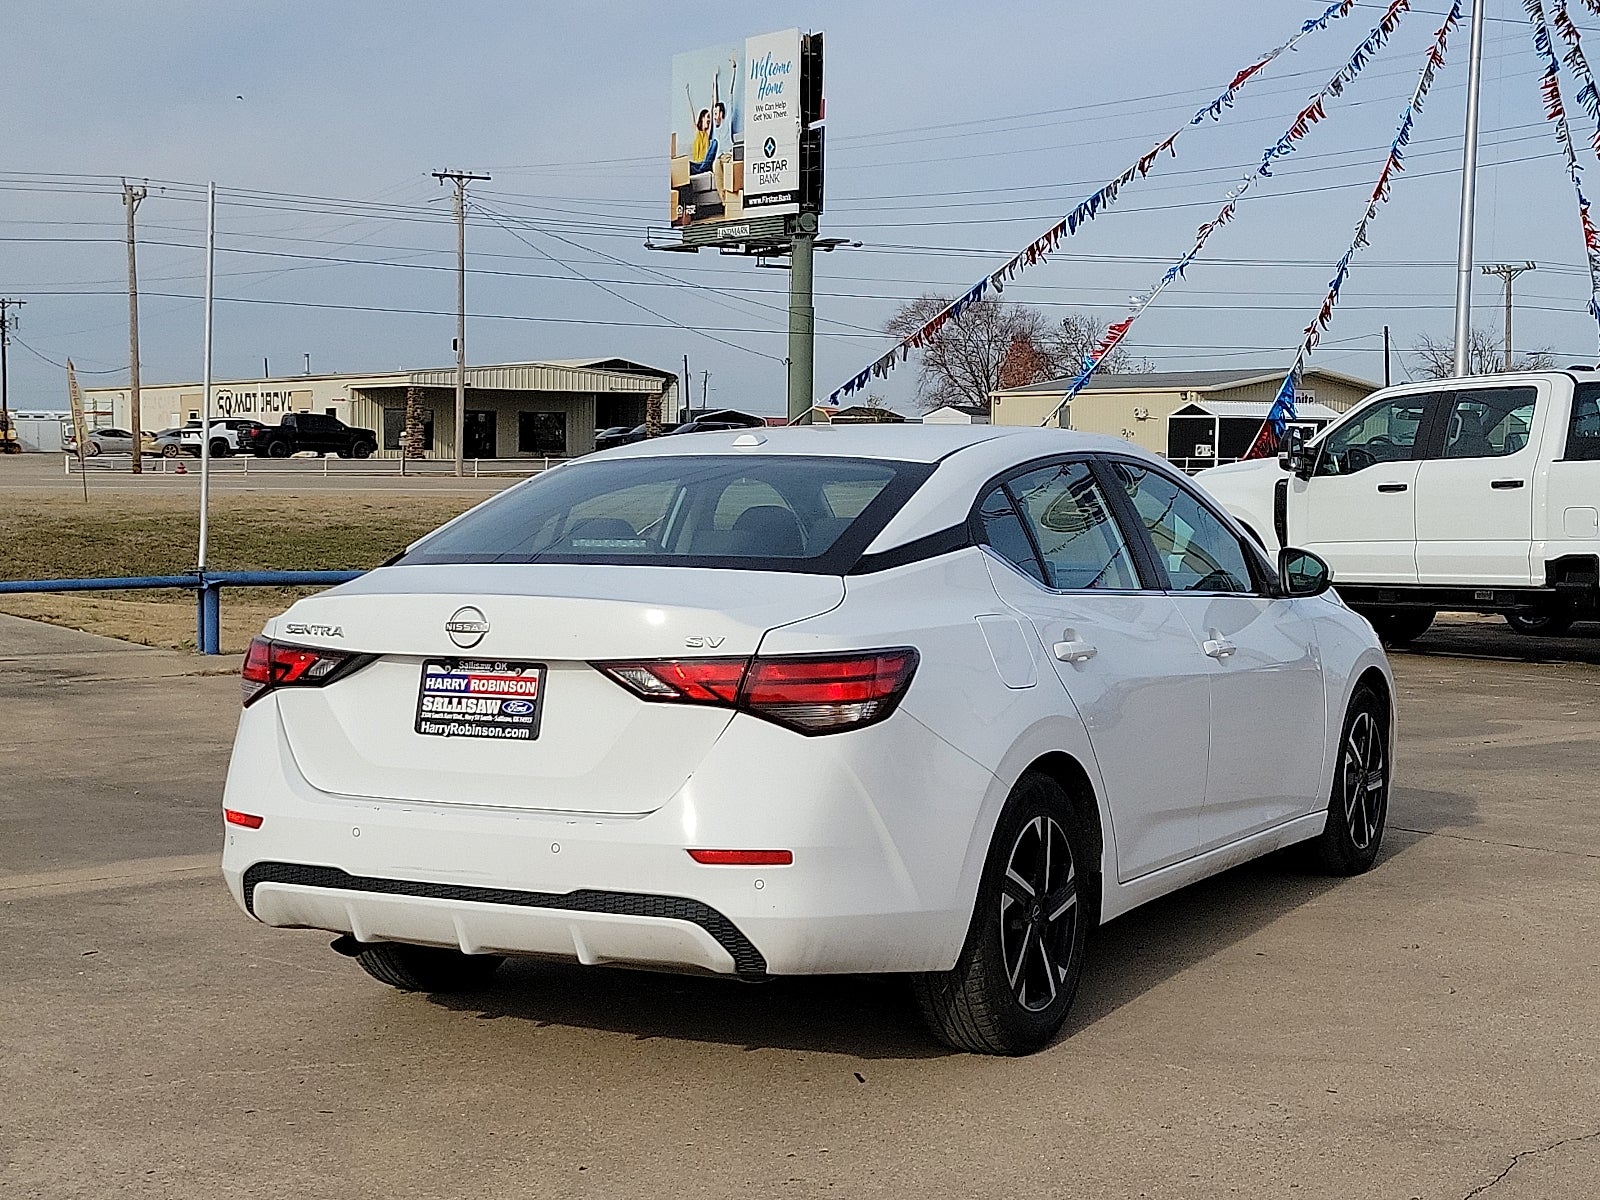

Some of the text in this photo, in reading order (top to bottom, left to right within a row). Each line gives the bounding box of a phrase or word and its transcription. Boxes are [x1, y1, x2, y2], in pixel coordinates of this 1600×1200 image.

[750, 51, 792, 79] Welcome
[757, 78, 784, 101] Home
[764, 103, 774, 111] Can
[775, 101, 787, 110] Help
[753, 113, 763, 121] Get
[763, 112, 773, 120] You
[752, 159, 788, 174] FIRSTAR
[760, 173, 780, 185] BANK
[285, 623, 344, 638] SENTRA
[446, 622, 490, 633] NISSAN
[685, 636, 726, 648] SV
[459, 661, 507, 671] Sallisaw, OK
[425, 678, 536, 693] HARRY ROBINSON
[422, 697, 531, 714] SALLISAW Ford
[421, 722, 530, 738] HarryRobinson.com
